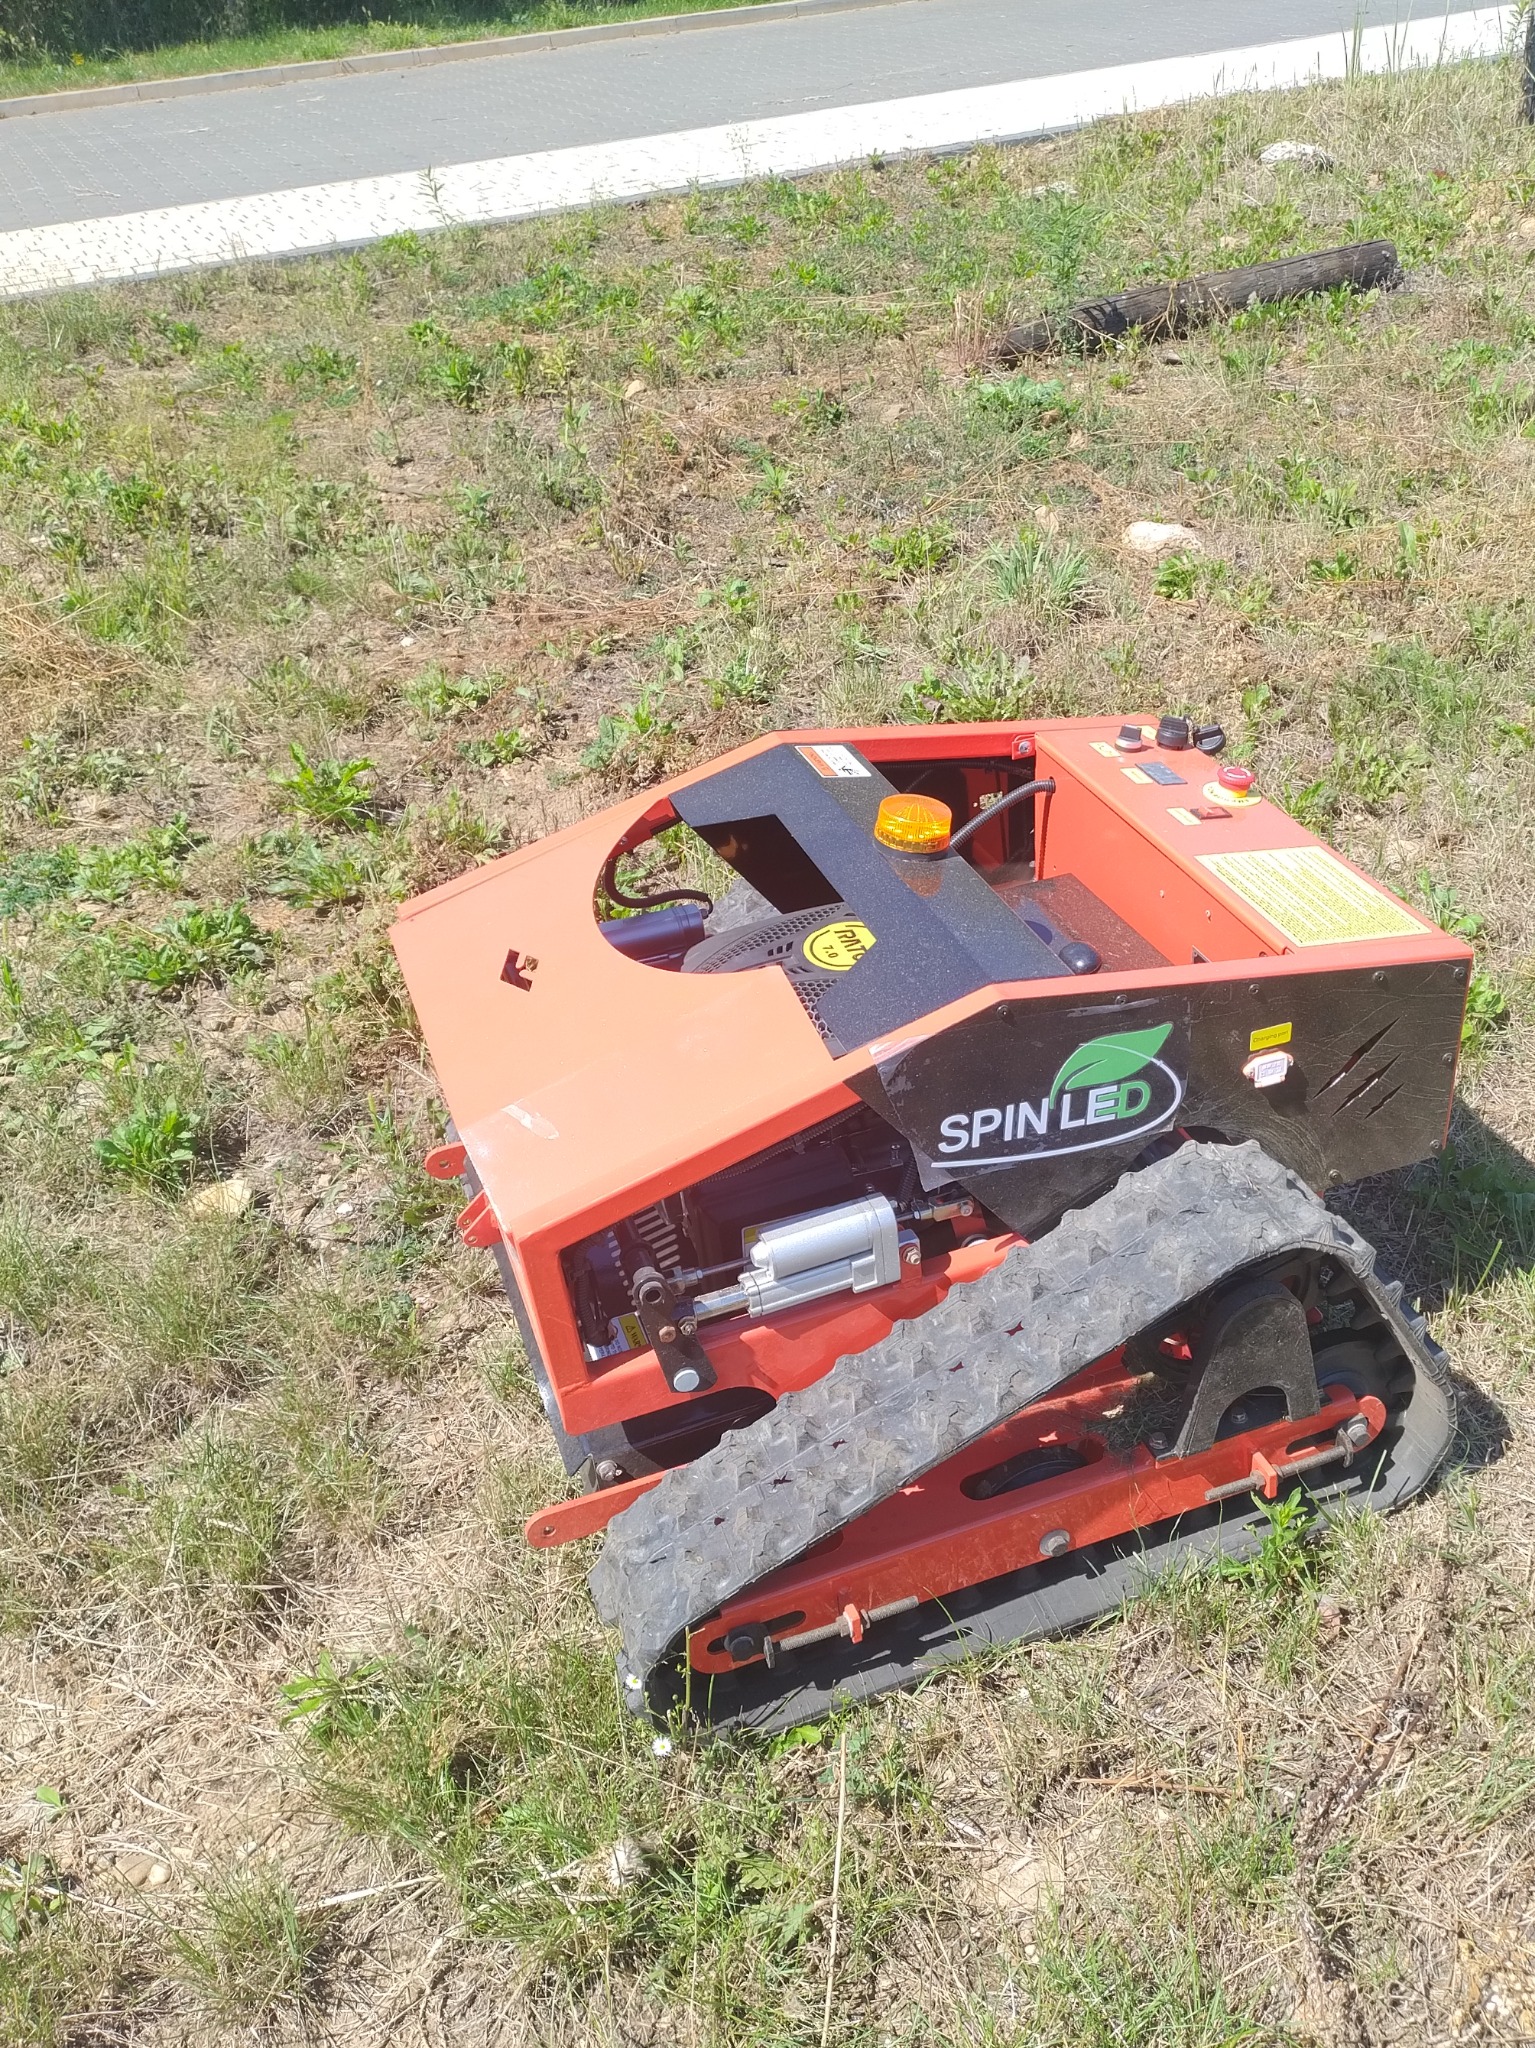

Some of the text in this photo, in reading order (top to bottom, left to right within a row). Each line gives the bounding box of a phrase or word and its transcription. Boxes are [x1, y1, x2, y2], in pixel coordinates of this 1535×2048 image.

[822, 945, 839, 958] 7.0
[1253, 1033, 1277, 1042] Charging
[938, 1080, 1151, 1154] SPIN LED
